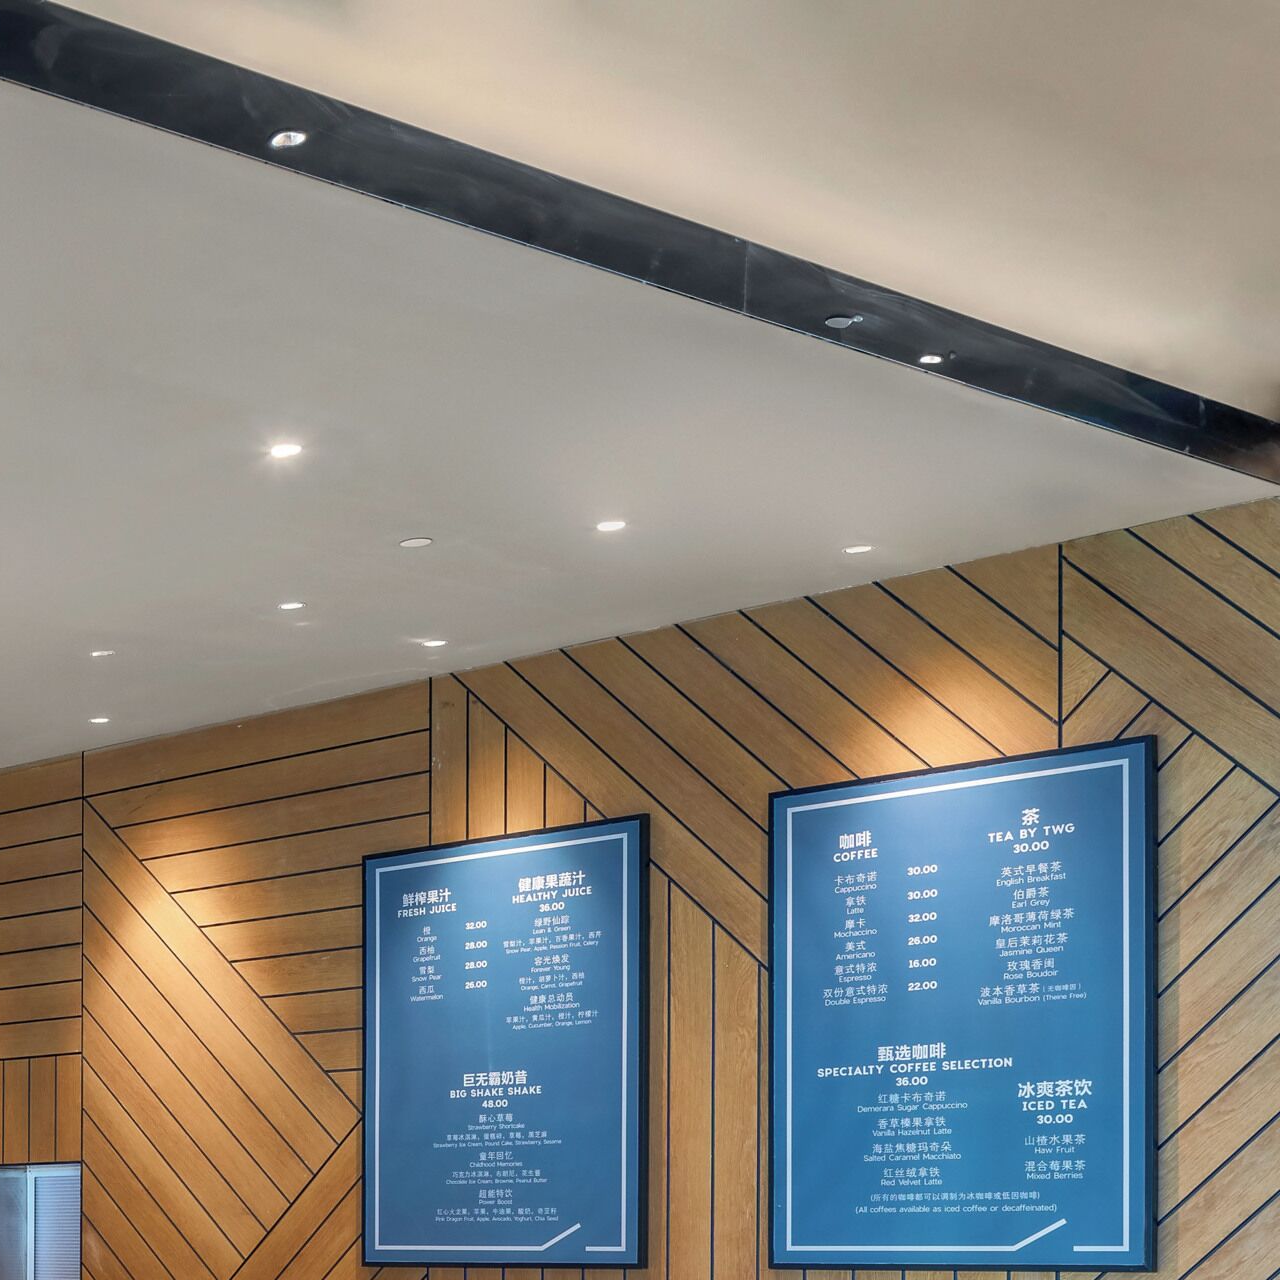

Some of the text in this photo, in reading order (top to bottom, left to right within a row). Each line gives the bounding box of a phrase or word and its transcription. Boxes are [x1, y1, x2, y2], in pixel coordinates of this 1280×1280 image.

[1022, 808, 1040, 826] 茶
[988, 823, 1075, 843] TEA BY TWG
[839, 830, 872, 850] 咖啡
[1013, 840, 1050, 853] 30.00
[833, 848, 878, 862] COFFEE
[907, 864, 938, 876] 30.00
[1001, 861, 1062, 878] 英式早餐茶
[518, 871, 586, 892] 健康果蔬汁
[834, 871, 878, 886] 卡布奇诺
[996, 872, 1066, 887] English Breakfast
[834, 883, 877, 894] Cappuccino
[907, 889, 938, 900] 30.00
[1013, 886, 1049, 900] 伯爵茶
[402, 889, 451, 907] 鲜榨果汁
[512, 886, 592, 904] HEALTHY JUICE
[845, 895, 866, 907] 拿铁
[539, 901, 565, 912] 36.00
[1011, 899, 1050, 909] Earl Grey
[398, 903, 457, 918] FRESH JUICE
[846, 907, 864, 915] Latte
[908, 912, 937, 923] 32.00
[465, 920, 487, 930] 32.00
[844, 918, 866, 930] 摩卡
[834, 928, 878, 938] Mochaccino
[465, 940, 488, 950] 28.00
[845, 940, 866, 952] 美式
[908, 935, 938, 946] 26.00
[995, 932, 1068, 949] 皇后茉莉花茶
[835, 951, 876, 961] Americano
[999, 946, 1064, 957] Jasmine Queen
[465, 960, 488, 969] 28.00
[834, 962, 877, 976] 意式特浓
[909, 958, 937, 968] 16.00
[465, 980, 487, 989] 26.00
[837, 974, 872, 983] Espresso
[419, 985, 435, 995] 西瓜
[823, 983, 888, 999] 双份意式特浓
[908, 981, 938, 991] 22.00
[410, 994, 444, 1002] Watermelon
[824, 996, 886, 1007] Double Espresso
[877, 1043, 946, 1061] 甄选咖啡
[817, 1057, 1012, 1077] SPECIALTY COFFEE SELECTION
[463, 1070, 528, 1087] 巨无霸奶昔
[896, 1076, 928, 1087] 36.00
[450, 1085, 542, 1098] BIG SHAKE SHAKE
[1018, 1079, 1092, 1098] 冰爽茶饮
[878, 1090, 946, 1104] 红糖卡布奇诺
[482, 1099, 508, 1108] 48.00
[857, 1102, 968, 1113] Demerara Sugar Cappuccino
[1022, 1099, 1088, 1111] ICED TEA
[1036, 1114, 1073, 1124] 30.00
[1025, 1134, 1086, 1146] 山楂水果茶
[883, 1166, 940, 1178] 红丝绒拿铁
[880, 1178, 943, 1186] Red Velvet Latte
